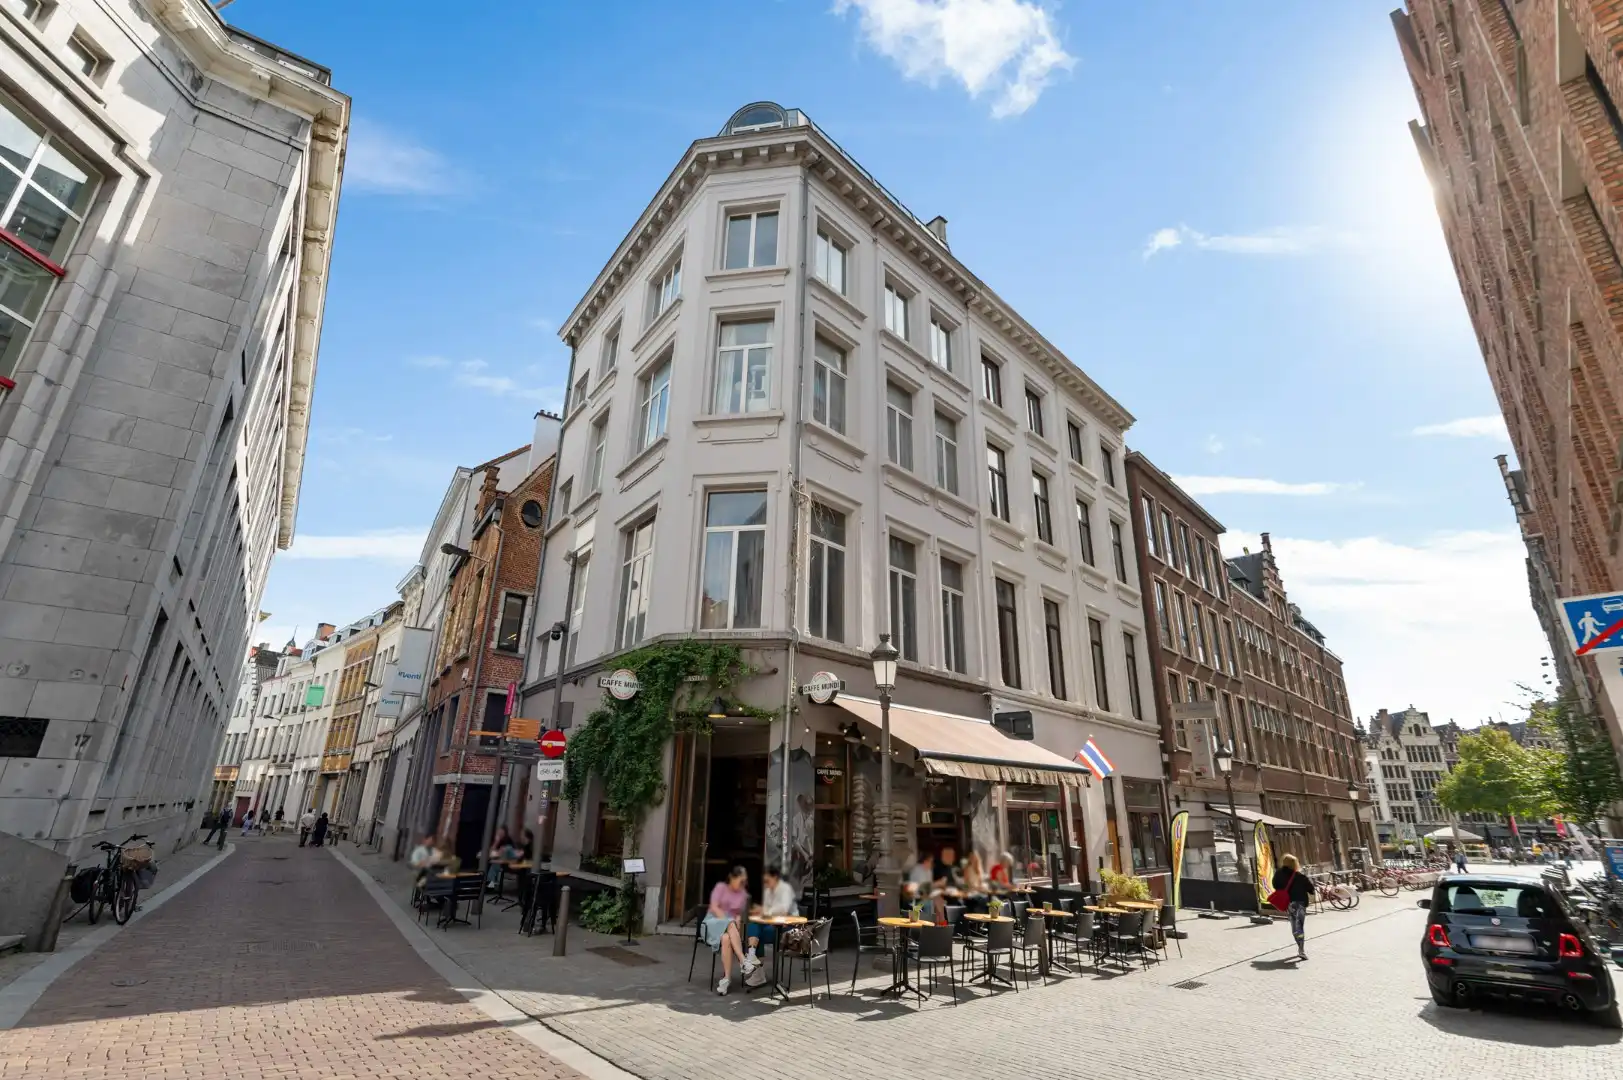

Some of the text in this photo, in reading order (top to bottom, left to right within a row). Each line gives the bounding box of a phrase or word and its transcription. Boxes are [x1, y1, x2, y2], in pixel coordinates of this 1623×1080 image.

[601, 678, 622, 687] CAFFE
[804, 682, 839, 692] CAFFE MUNDI
[75, 733, 92, 747] 17
